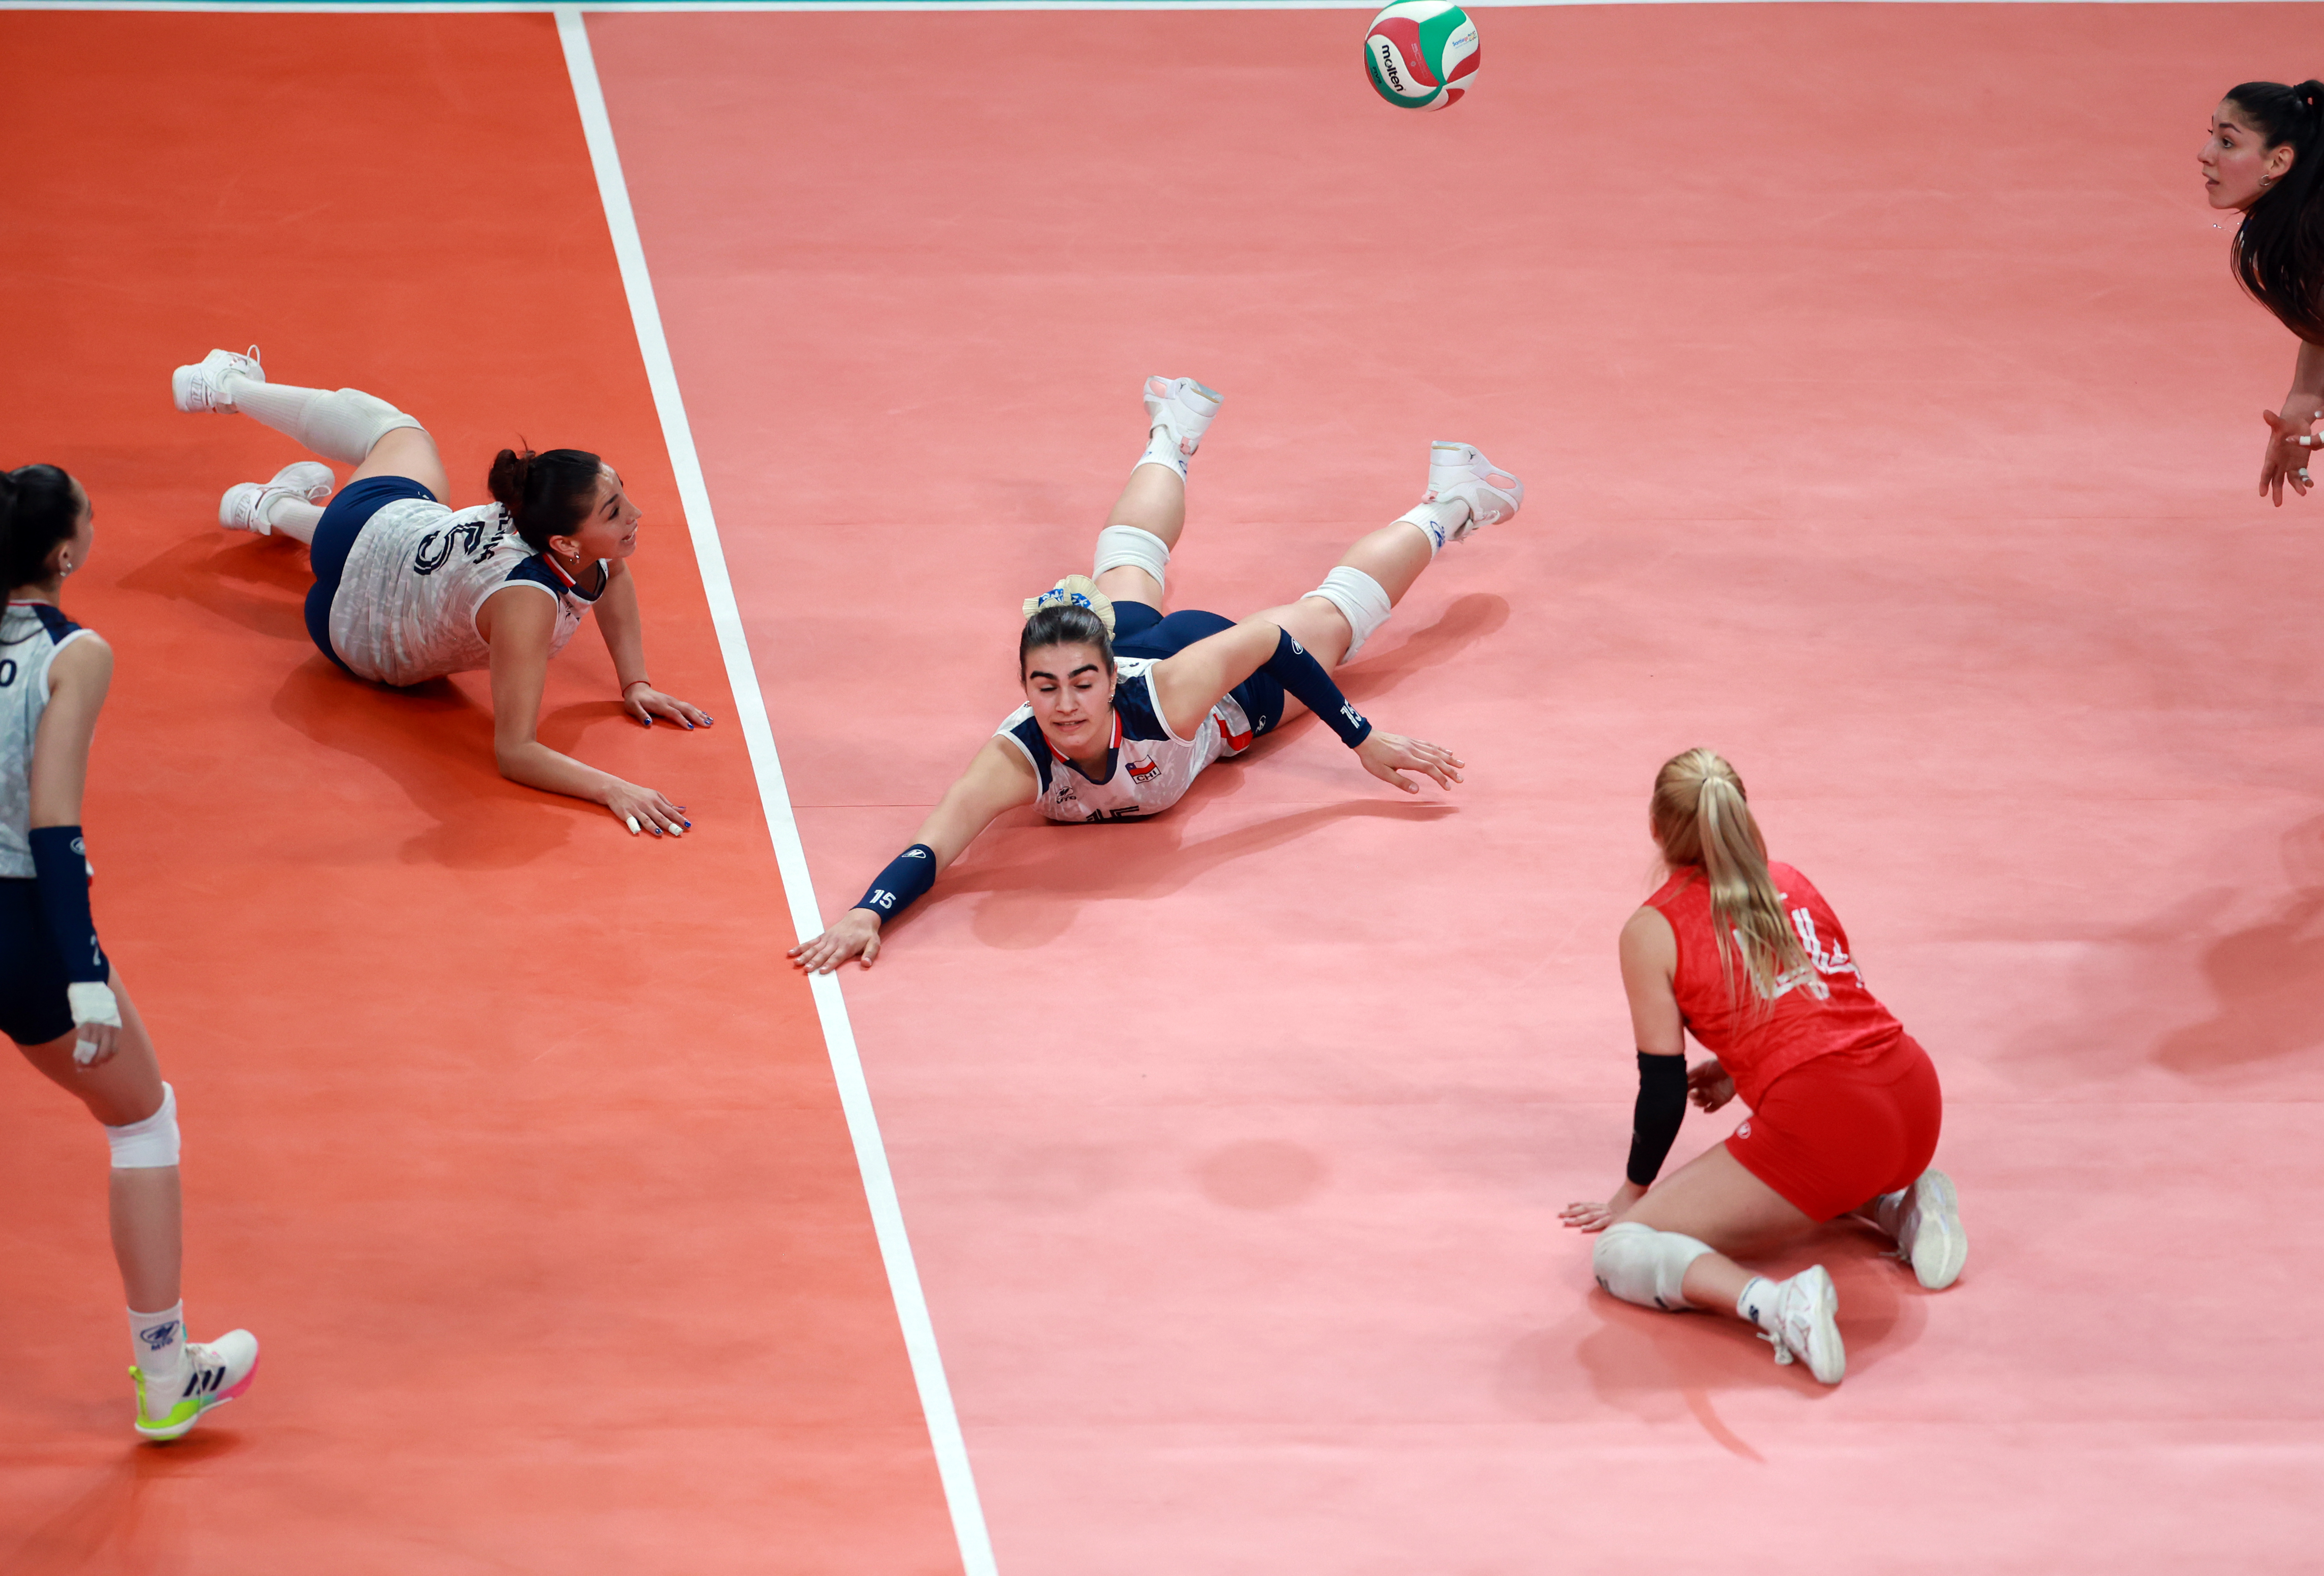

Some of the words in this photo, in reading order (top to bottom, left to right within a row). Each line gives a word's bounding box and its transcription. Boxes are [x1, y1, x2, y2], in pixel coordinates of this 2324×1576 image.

[1382, 45, 1404, 92] molten
[413, 521, 485, 576] 5
[1340, 698, 1362, 729] 15
[1136, 770, 1157, 781] CHI
[869, 889, 896, 909] 15
